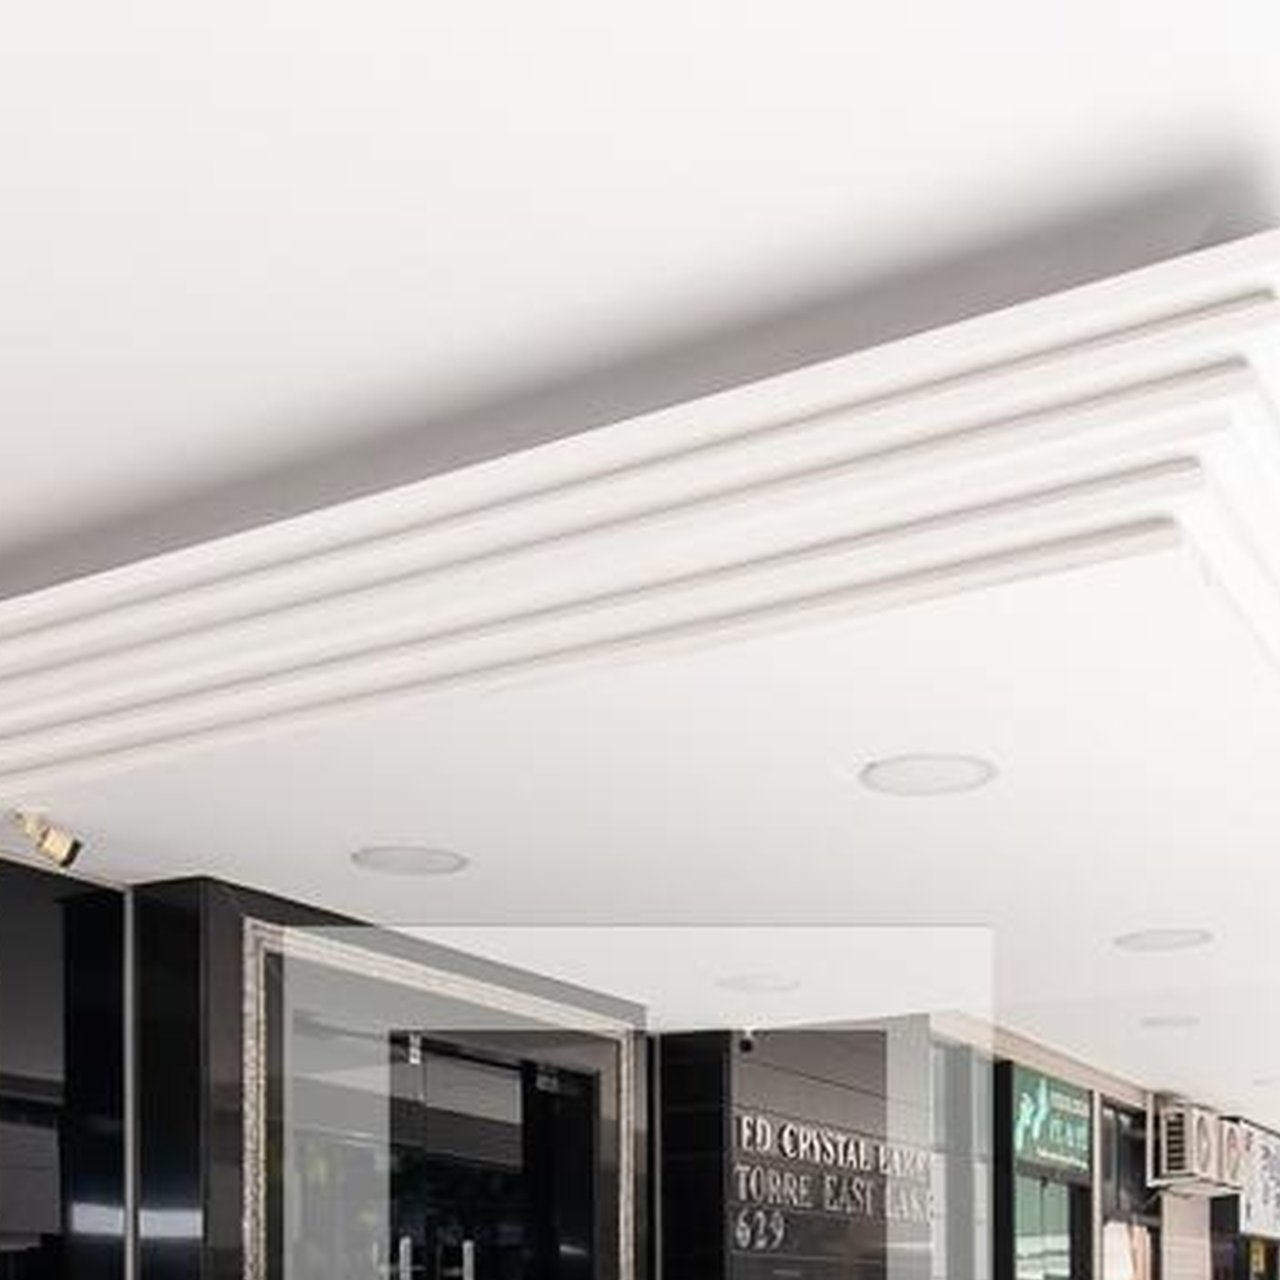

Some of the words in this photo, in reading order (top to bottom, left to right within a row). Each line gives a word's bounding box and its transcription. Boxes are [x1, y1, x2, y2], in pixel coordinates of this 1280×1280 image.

[740, 1114, 772, 1152] ED
[780, 1123, 871, 1171] CRYSTAL
[734, 1163, 815, 1208] TORRE
